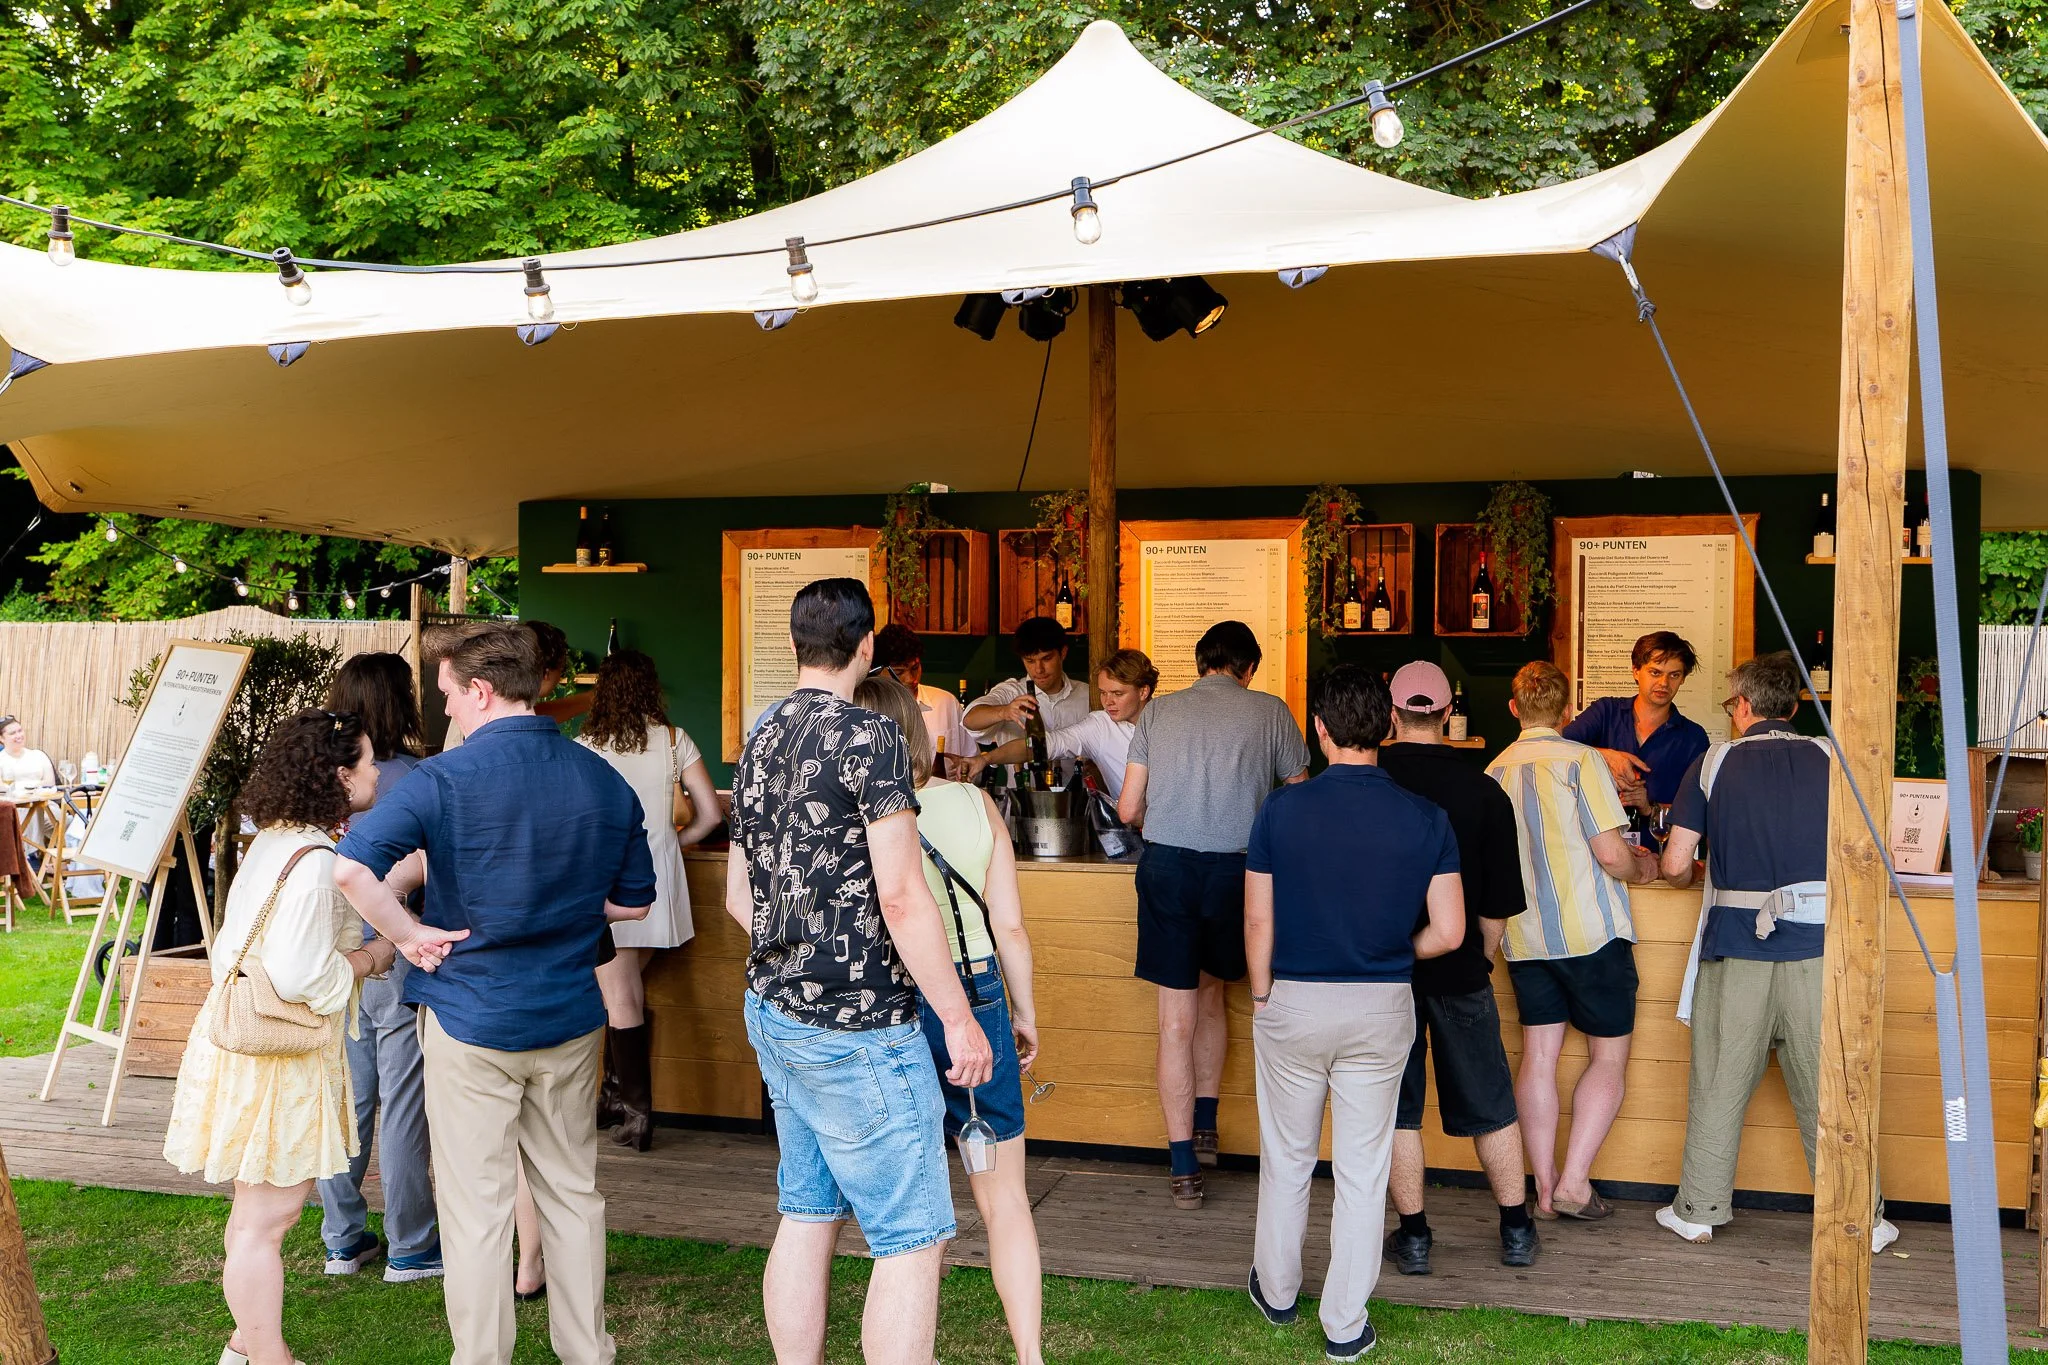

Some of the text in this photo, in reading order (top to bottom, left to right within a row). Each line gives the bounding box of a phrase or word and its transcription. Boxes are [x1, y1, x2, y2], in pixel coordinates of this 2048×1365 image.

[1580, 541, 1647, 550] 90+ PUNTEN
[1146, 546, 1207, 555] 90+ PUNTEN
[747, 552, 802, 561] 90+ PUNTEN
[176, 670, 219, 685] 90+ PUNTEN
